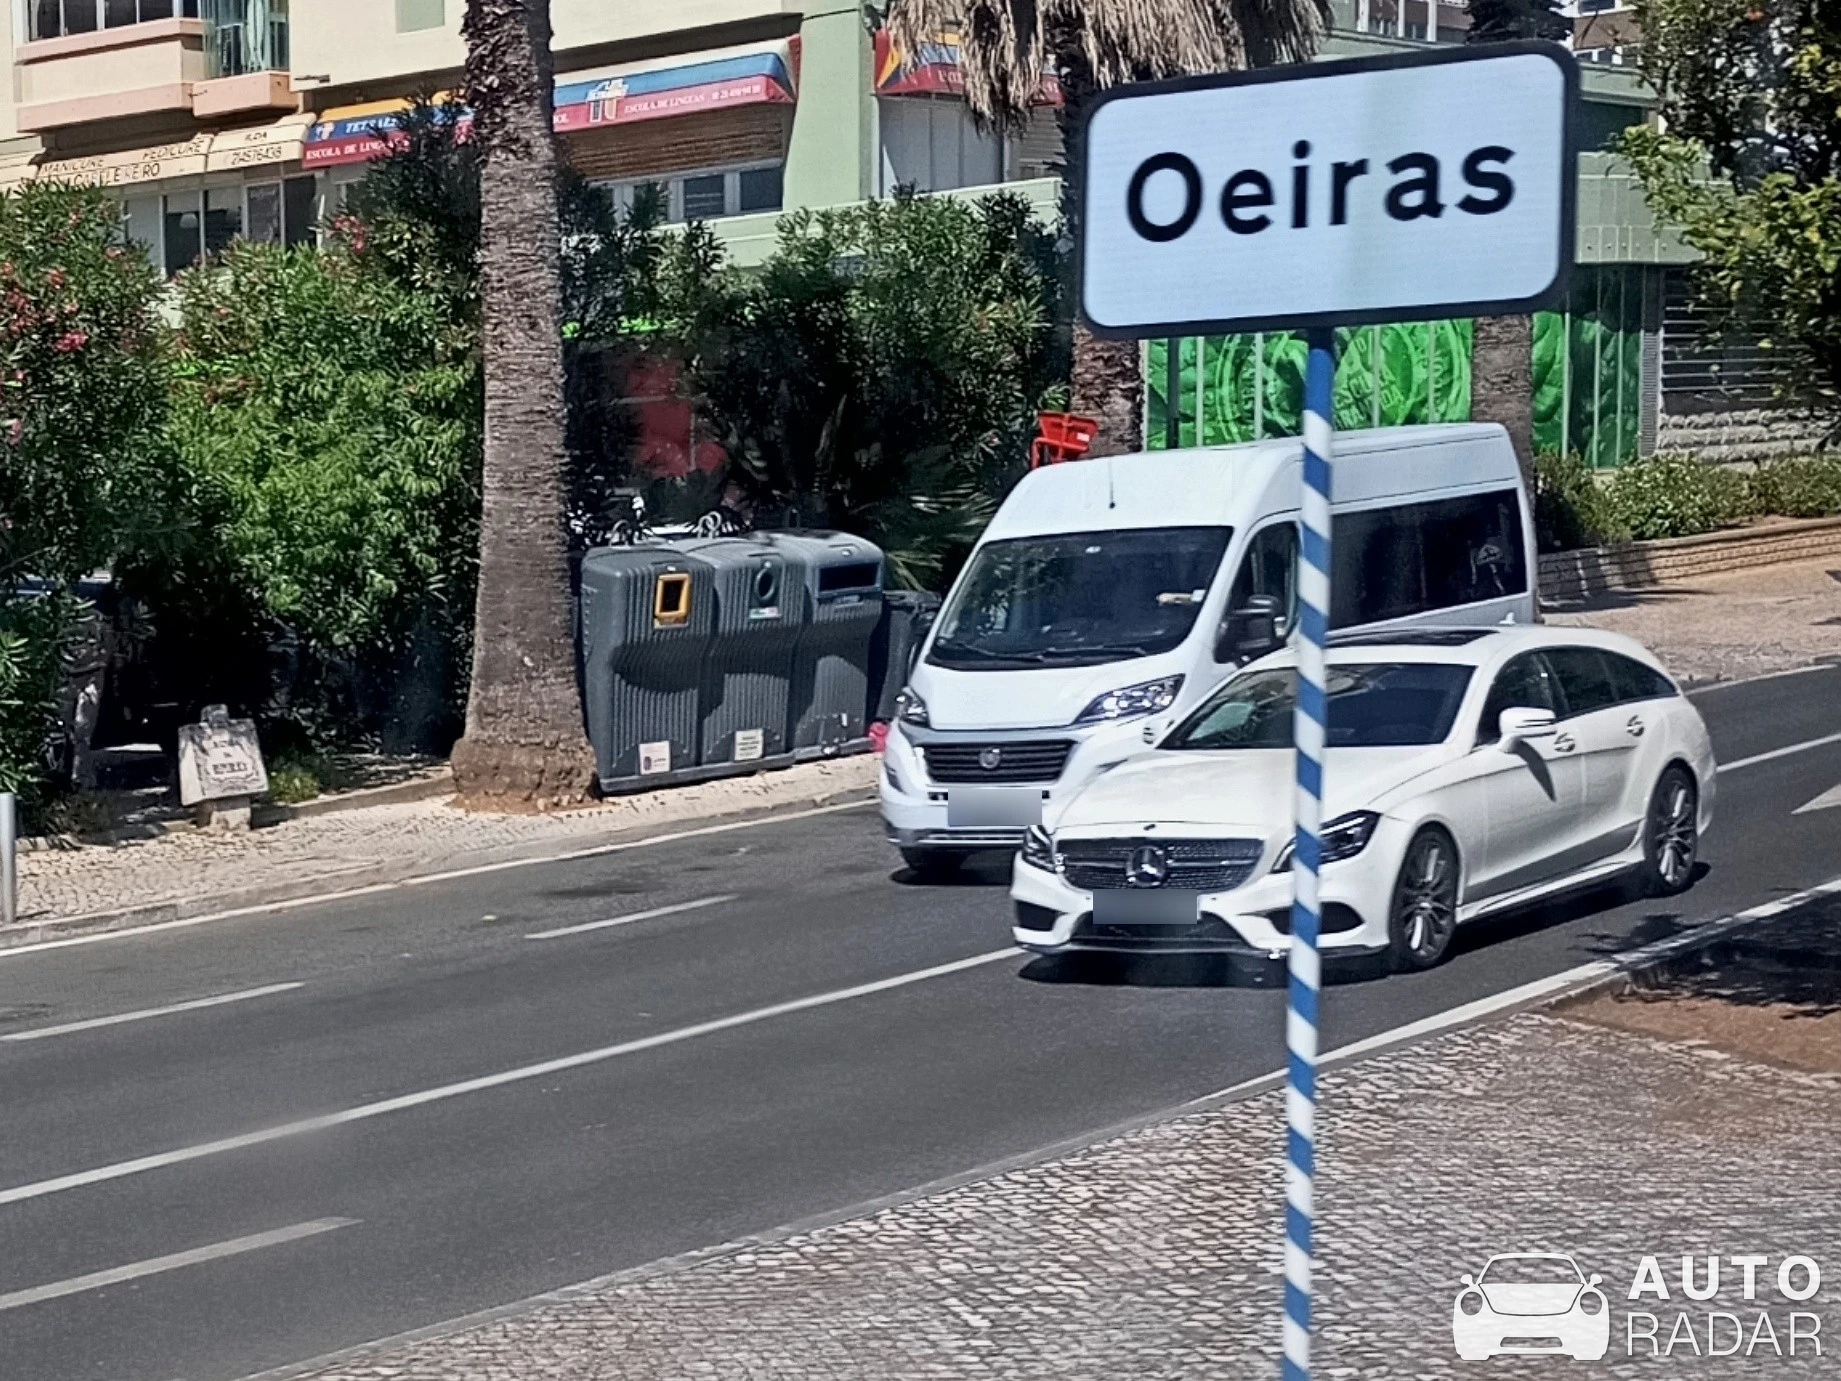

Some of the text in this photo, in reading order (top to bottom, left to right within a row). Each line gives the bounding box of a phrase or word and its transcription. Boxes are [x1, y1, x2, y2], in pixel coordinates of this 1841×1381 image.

[306, 146, 341, 160] ESCOLA
[344, 143, 357, 155] DE
[1126, 139, 1516, 243] Oeiras
